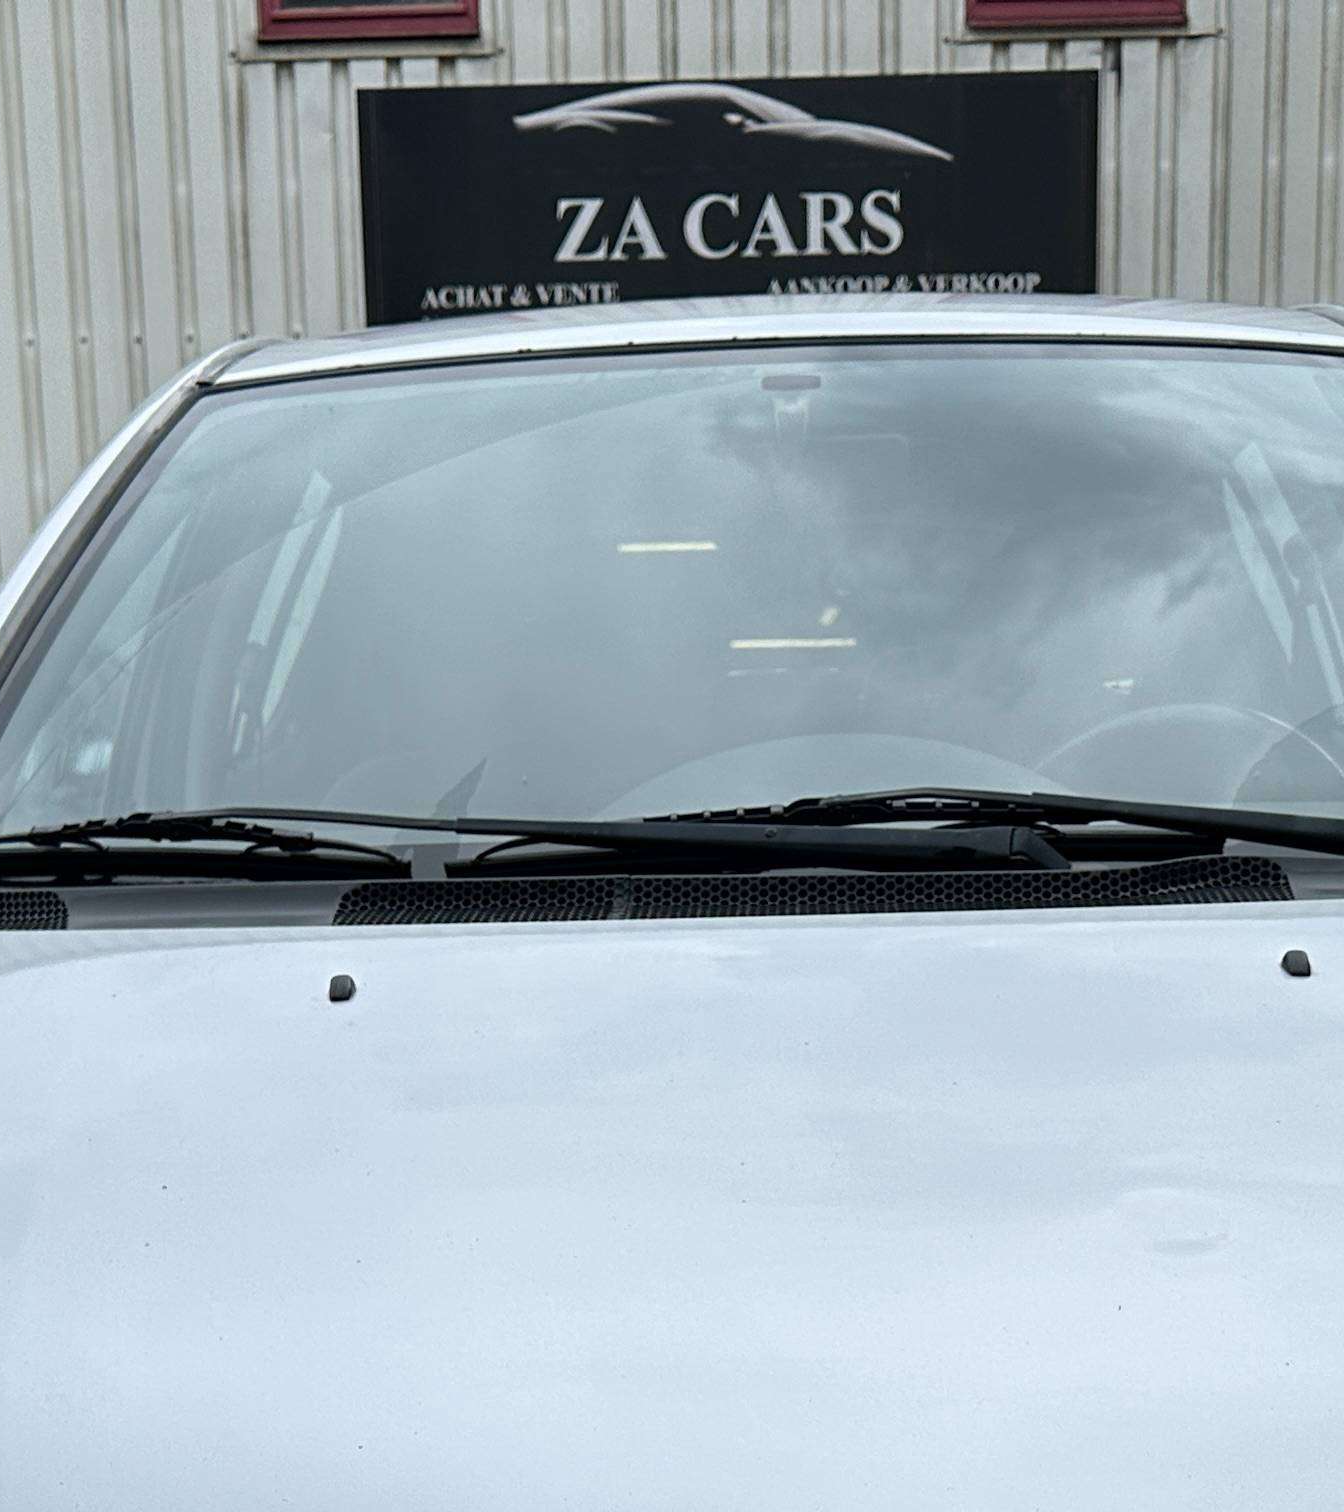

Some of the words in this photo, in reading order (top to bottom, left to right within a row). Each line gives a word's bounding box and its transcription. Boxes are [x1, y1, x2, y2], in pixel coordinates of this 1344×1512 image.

[554, 195, 668, 262] ZA
[683, 189, 904, 260] CARS
[421, 283, 507, 310] ACHAT
[509, 283, 532, 307] &
[534, 280, 621, 305] VENTE
[917, 271, 1042, 295] VERKOOP
